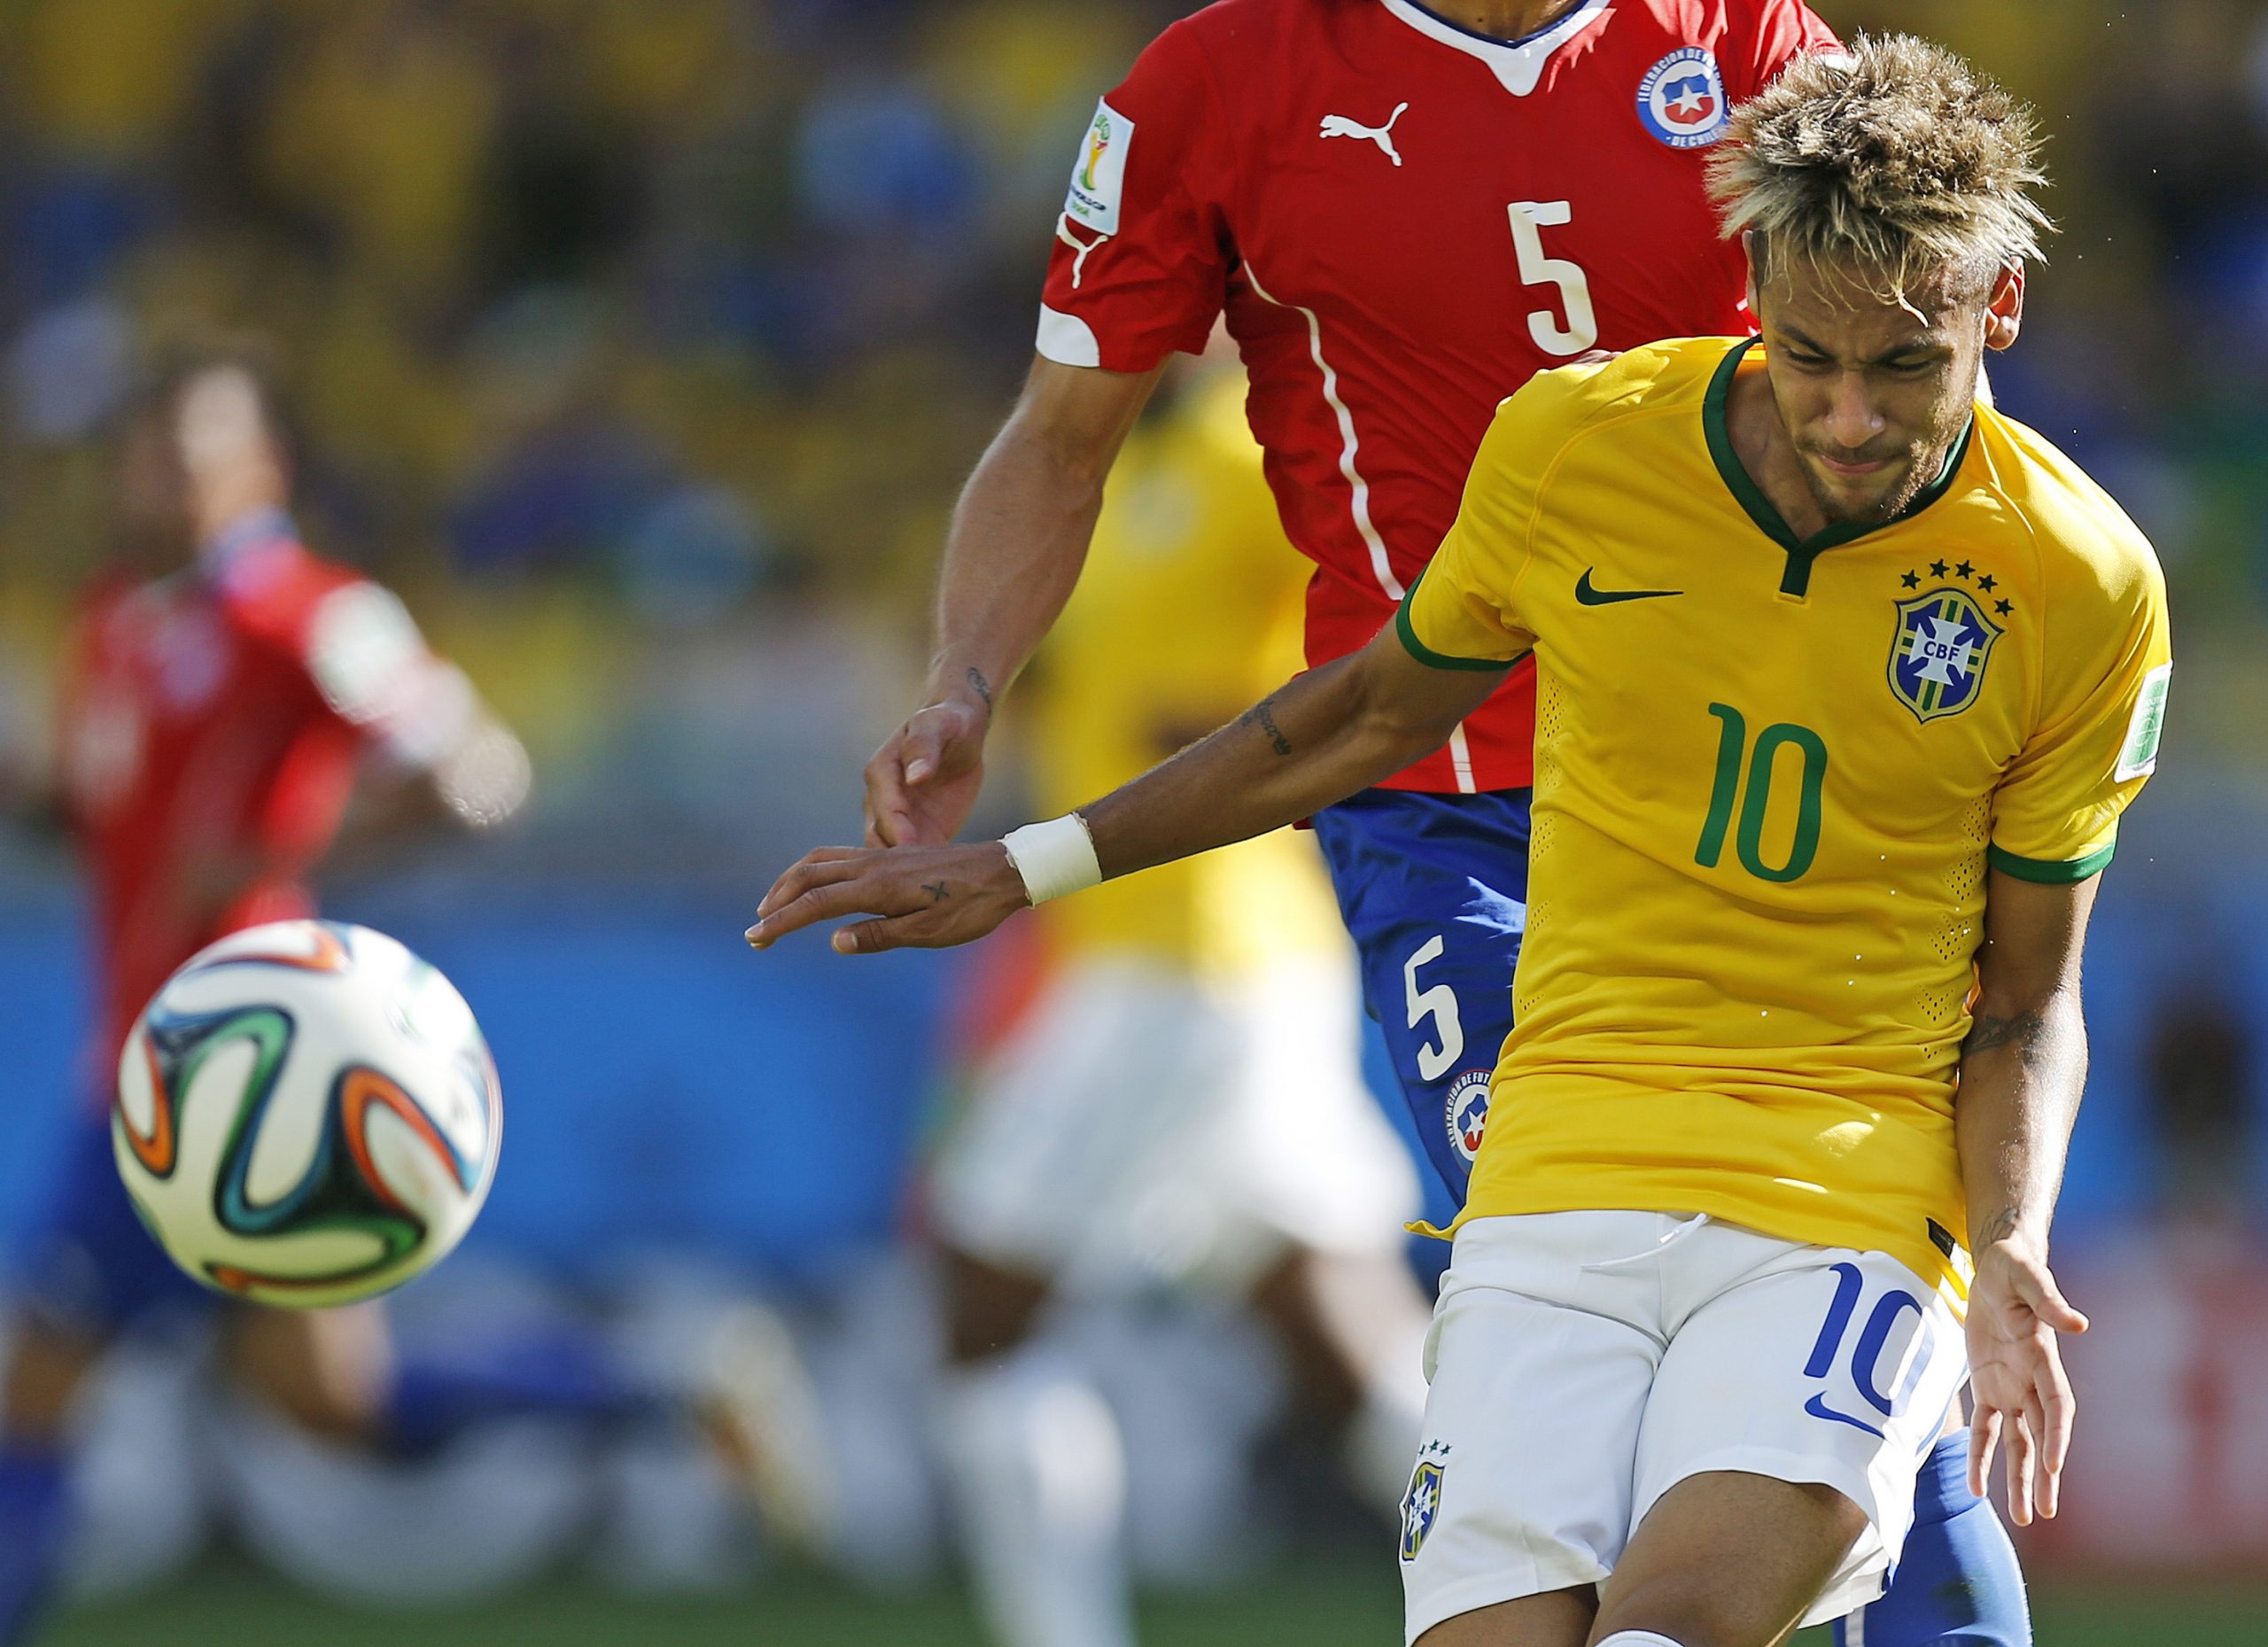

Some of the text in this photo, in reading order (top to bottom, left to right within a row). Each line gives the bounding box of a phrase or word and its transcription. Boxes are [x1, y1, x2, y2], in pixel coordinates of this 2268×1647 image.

[1507, 200, 1598, 356] 5
[1923, 641, 1961, 662] CBF
[1694, 702, 1828, 883] 10
[1404, 935, 1464, 1081] 5
[1803, 1262, 1935, 1418] 10
